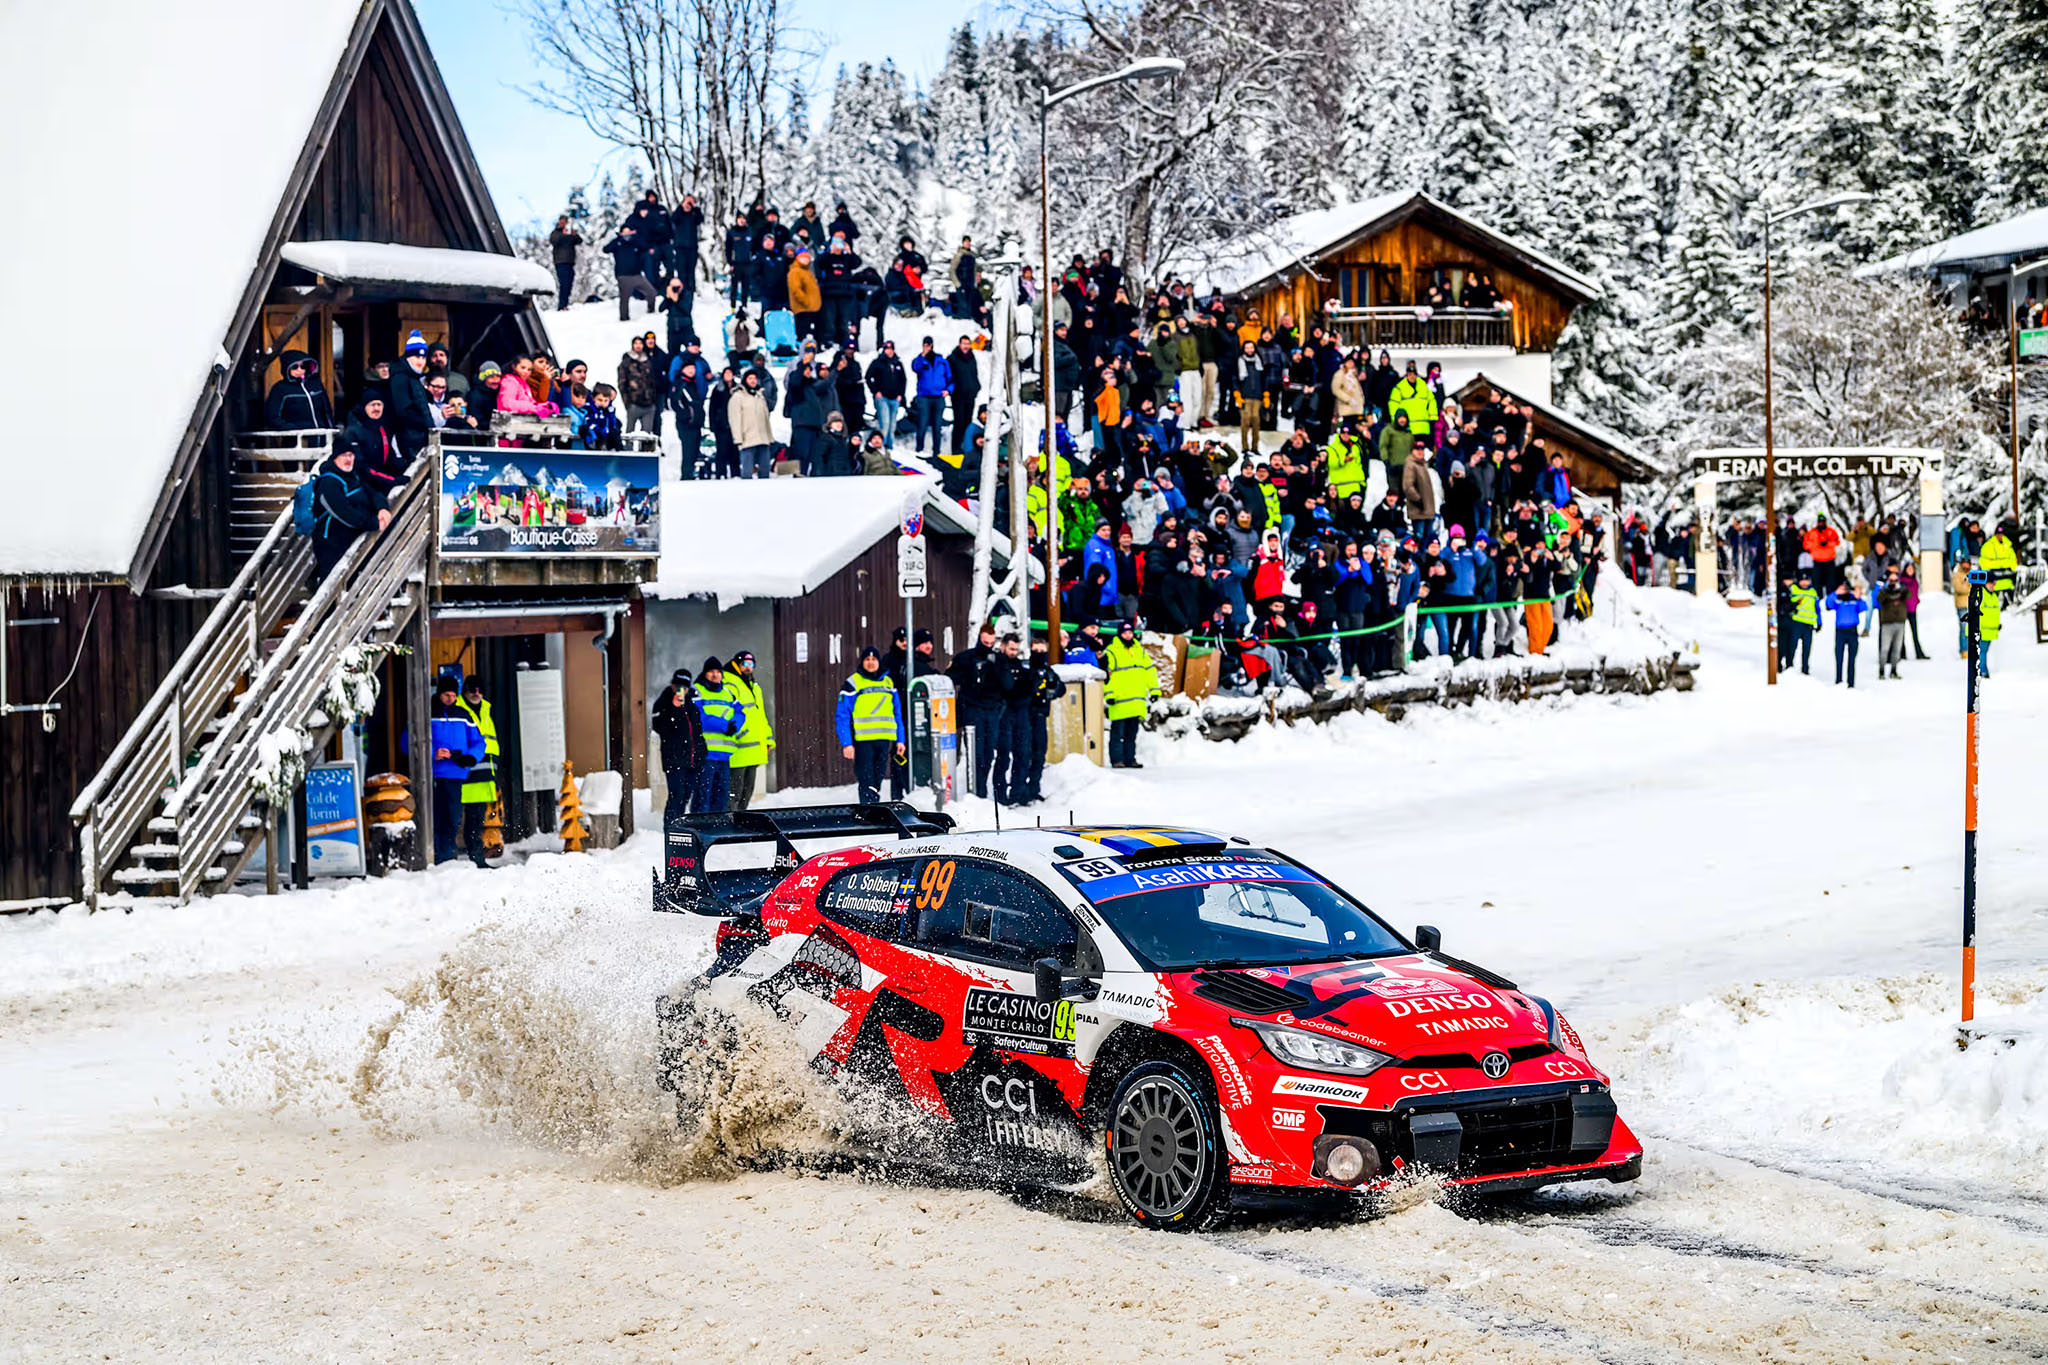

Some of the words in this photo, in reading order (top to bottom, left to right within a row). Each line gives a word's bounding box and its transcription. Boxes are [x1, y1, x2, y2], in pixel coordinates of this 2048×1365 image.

[1813, 457, 1856, 476] COL
[510, 527, 598, 548] Boutique-Caisse
[897, 845, 940, 856] AsahiKASEI
[967, 846, 1009, 861] PROTERIAL
[669, 856, 696, 868] DENSO
[1077, 860, 1117, 878] 99
[848, 873, 858, 890] O.
[860, 874, 900, 897] Solberg
[915, 859, 956, 910] 99
[1131, 864, 1284, 889] AsahiKASEI
[825, 892, 834, 909] E.
[835, 893, 893, 914] Edmondson
[1075, 904, 1098, 931] CENTRAL
[968, 991, 984, 1012] LE
[986, 995, 1051, 1020] CASINO
[1102, 990, 1156, 1009] TAMADIC
[1382, 993, 1492, 1018] DENSO
[1076, 1013, 1100, 1026] PIAA
[1415, 1016, 1510, 1036] TAMADIC
[1300, 1018, 1384, 1047] codebeamer
[993, 1035, 1049, 1052] SafetyCulture
[1193, 1037, 1243, 1111] AUTOMOTIVE
[1206, 1034, 1252, 1106] Panasonic
[1272, 1111, 1306, 1127] OMP
